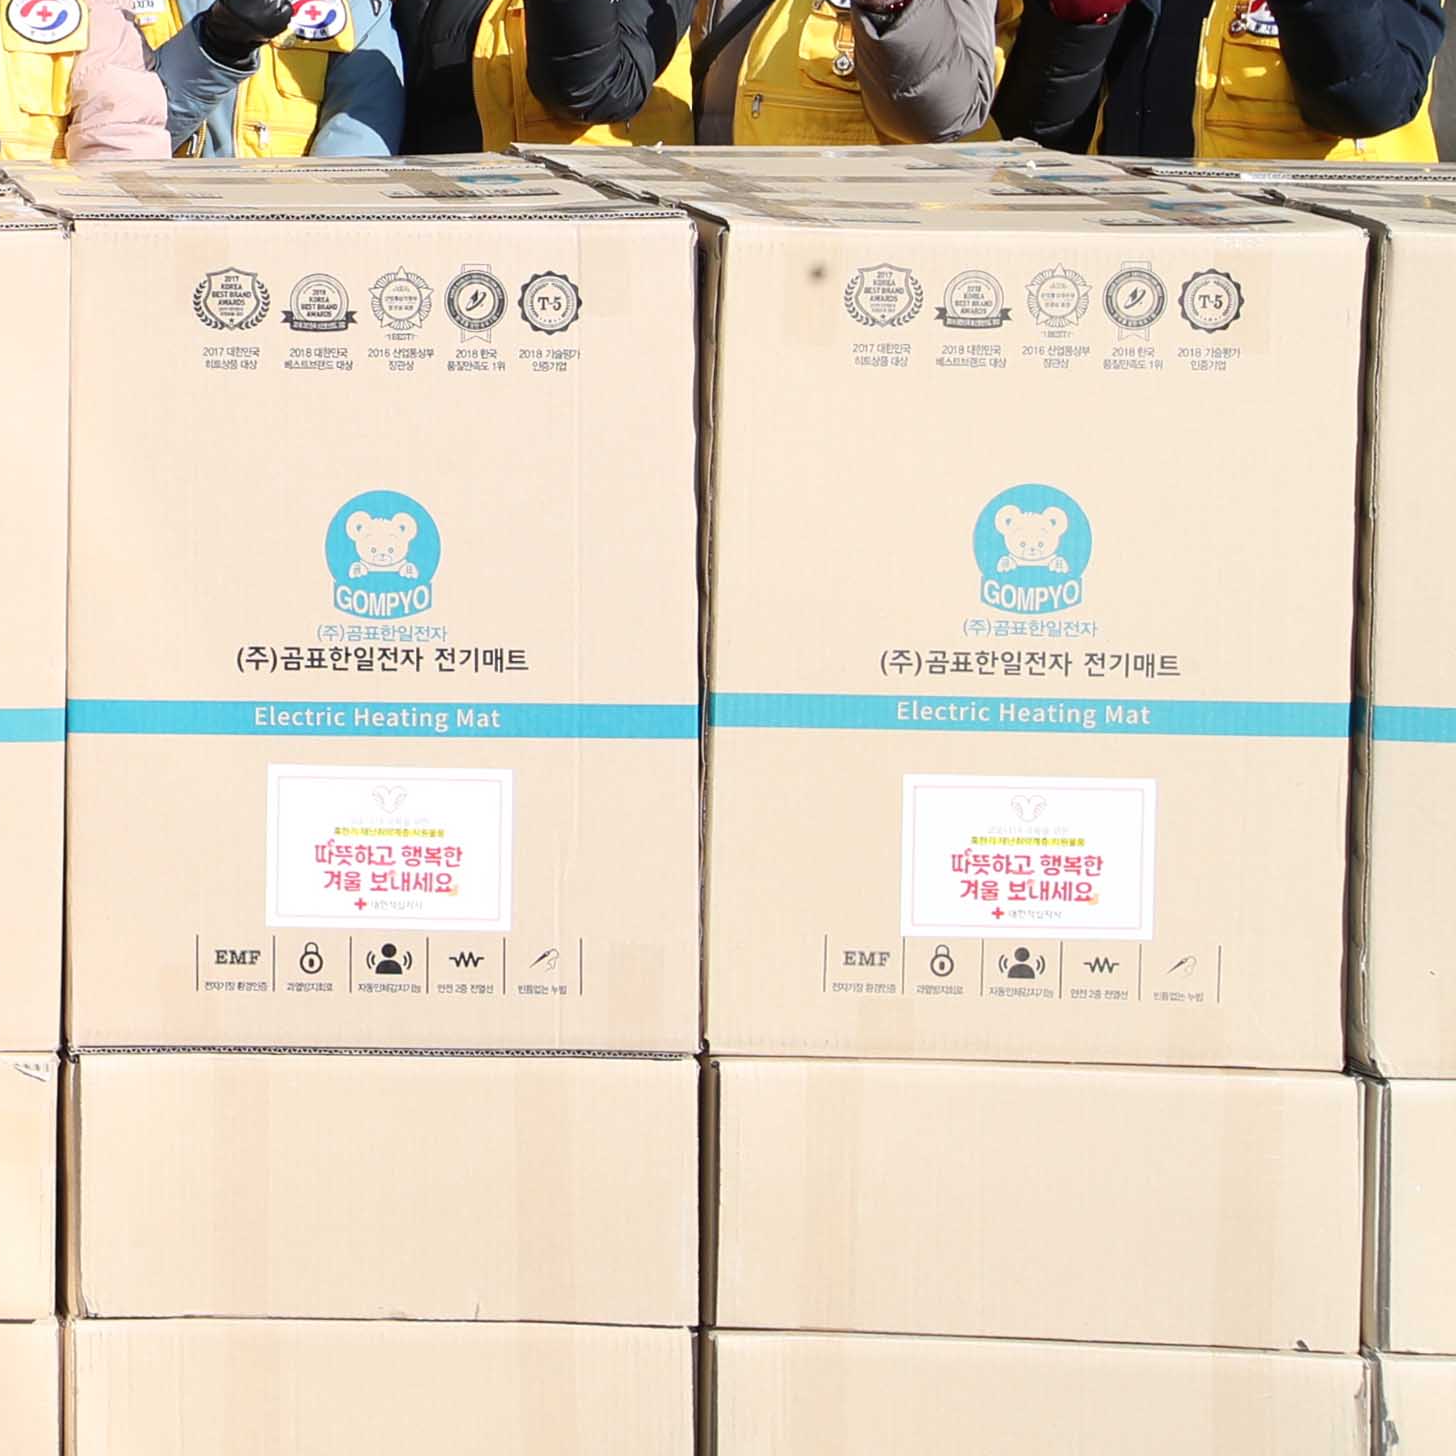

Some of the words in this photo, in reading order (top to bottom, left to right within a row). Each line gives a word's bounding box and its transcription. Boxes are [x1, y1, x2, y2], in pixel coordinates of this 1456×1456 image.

[537, 296, 561, 311] T-5
[1197, 294, 1223, 309] T-5
[336, 583, 430, 618] GOMPYO
[982, 577, 1080, 613] GOMPYO
[236, 643, 424, 676] (주)곰표한일전자
[434, 646, 529, 675] 전기매트
[879, 646, 1074, 680] (주)곰표한일전자
[1083, 651, 1181, 681] 전기매트
[254, 705, 346, 728] Electric
[353, 706, 449, 732] Heating
[456, 708, 501, 729] Mat
[896, 699, 991, 723] Electric
[998, 701, 1098, 728] Heating
[1104, 704, 1151, 725] Mat
[314, 838, 397, 867] 따뜻하고
[401, 845, 463, 868] 행복한
[951, 847, 1035, 876] 따뜻하고
[1040, 854, 1104, 877] 행복한
[323, 870, 362, 892] 겨울
[369, 870, 454, 893] 보내세요
[960, 879, 1000, 901] 겨울
[1007, 879, 1094, 902] 보내세요
[214, 948, 261, 966] EMF
[842, 949, 891, 968] EMF
